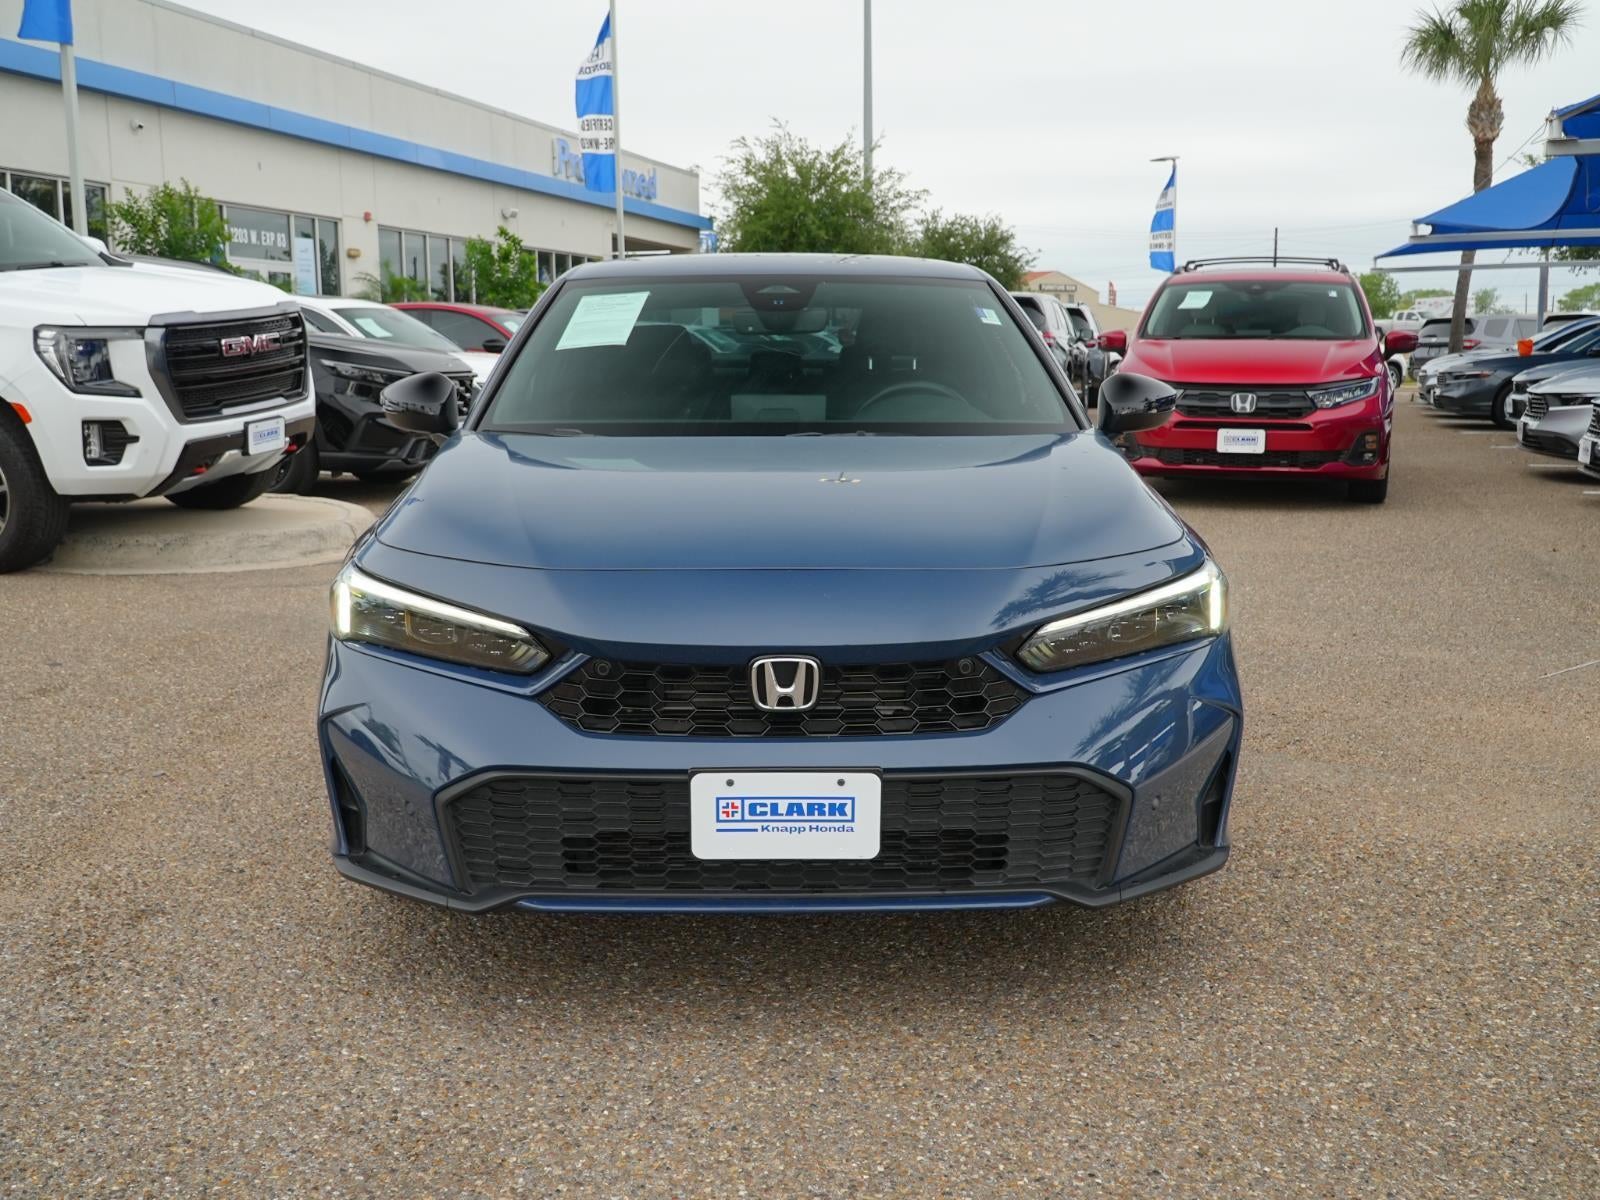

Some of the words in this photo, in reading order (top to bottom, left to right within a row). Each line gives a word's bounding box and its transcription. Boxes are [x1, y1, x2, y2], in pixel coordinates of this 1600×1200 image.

[230, 227, 249, 244] 1203
[261, 231, 275, 246] EXP
[221, 332, 280, 357] GMC
[748, 802, 848, 817] CLARK
[760, 824, 806, 835] Knapp
[808, 824, 855, 833] Honda
